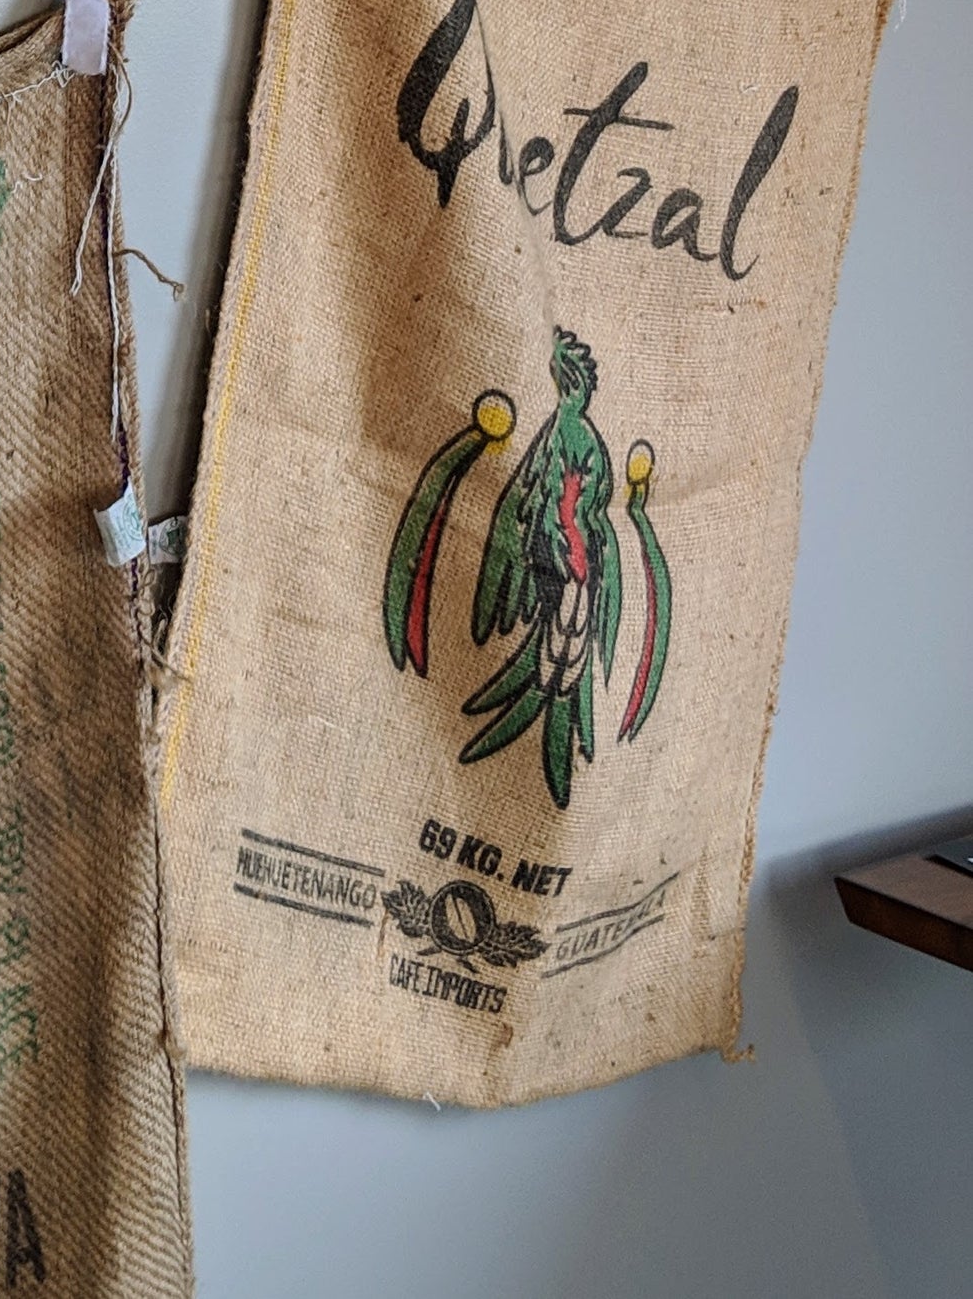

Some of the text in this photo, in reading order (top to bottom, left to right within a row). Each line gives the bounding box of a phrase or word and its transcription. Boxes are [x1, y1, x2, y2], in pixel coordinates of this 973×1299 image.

[419, 818, 573, 898] 69 KG. NET
[389, 952, 508, 1014] CAFE IMPORTS
